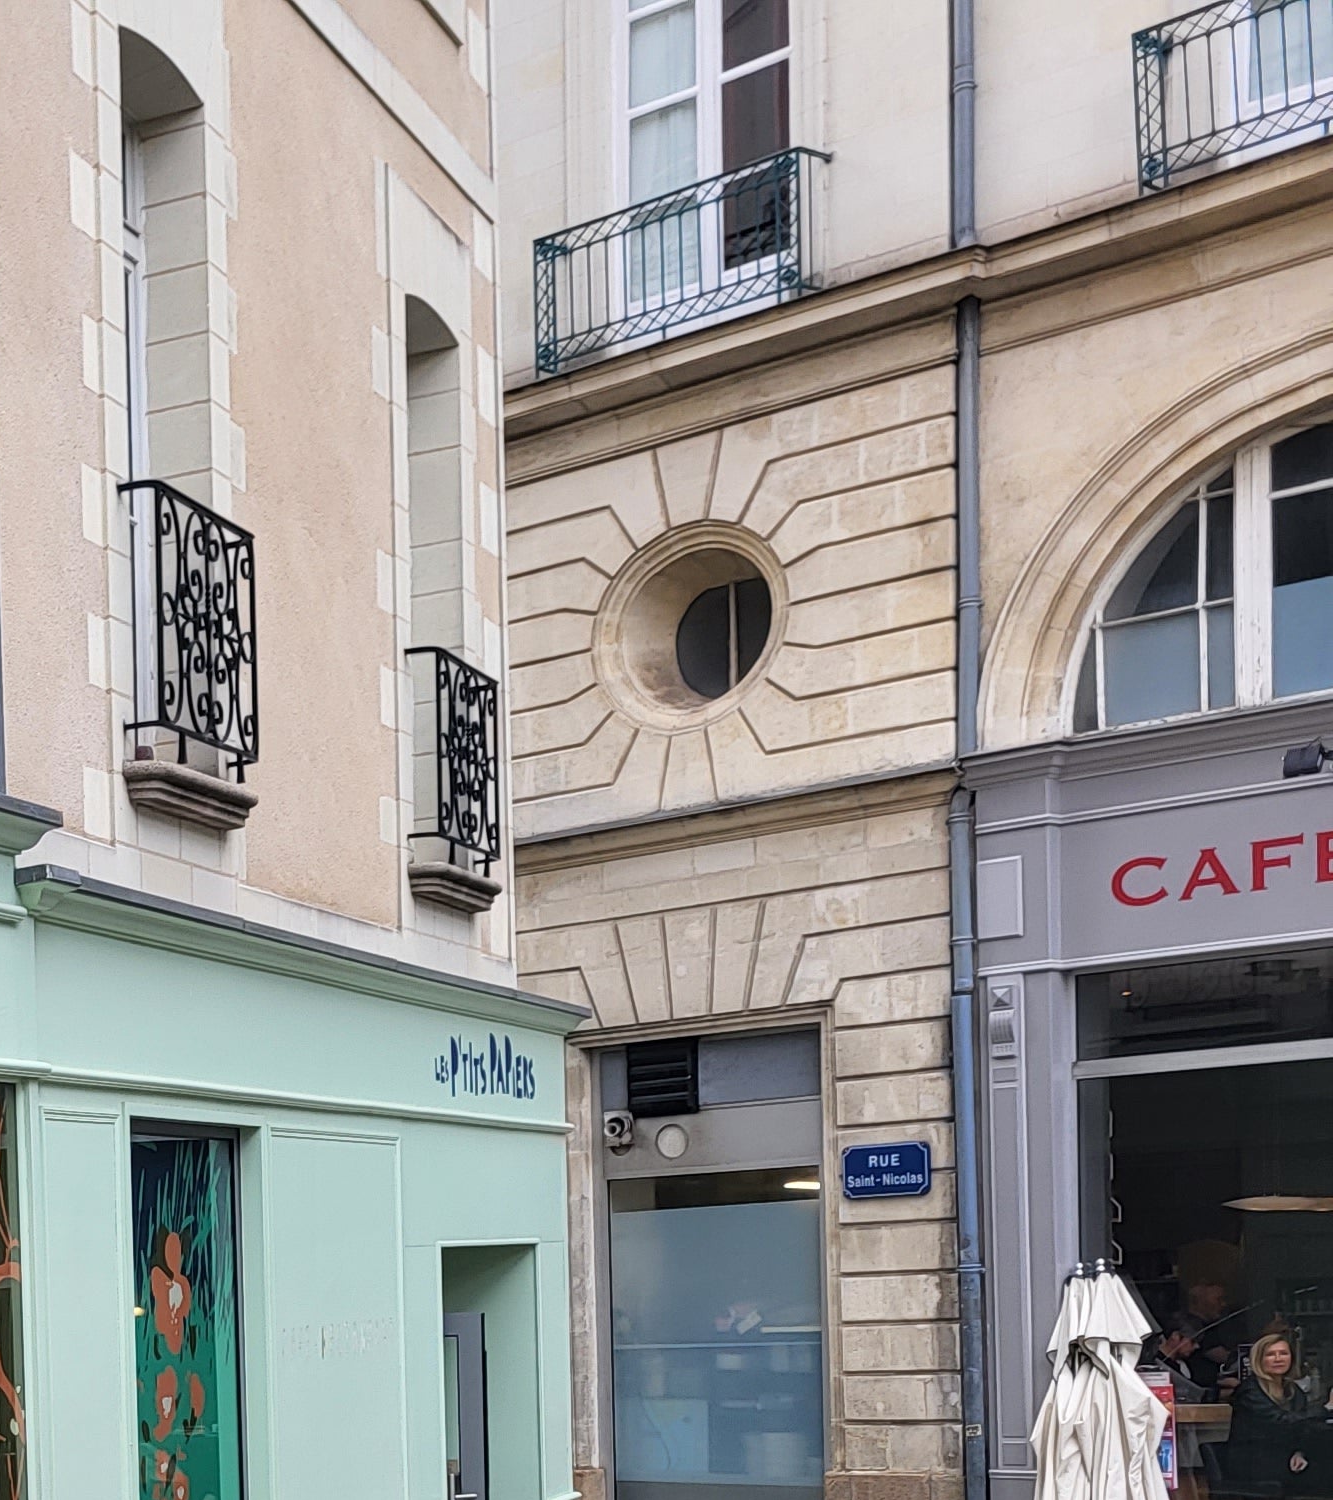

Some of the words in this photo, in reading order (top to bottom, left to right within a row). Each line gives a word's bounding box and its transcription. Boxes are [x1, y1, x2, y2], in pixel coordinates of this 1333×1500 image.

[434, 1055, 449, 1084] LES
[450, 1033, 487, 1097] P'TITS
[489, 1032, 535, 1100] PAPIERS
[868, 1153, 901, 1168] RUE
[847, 1172, 924, 1188] Saint-Nicolas
